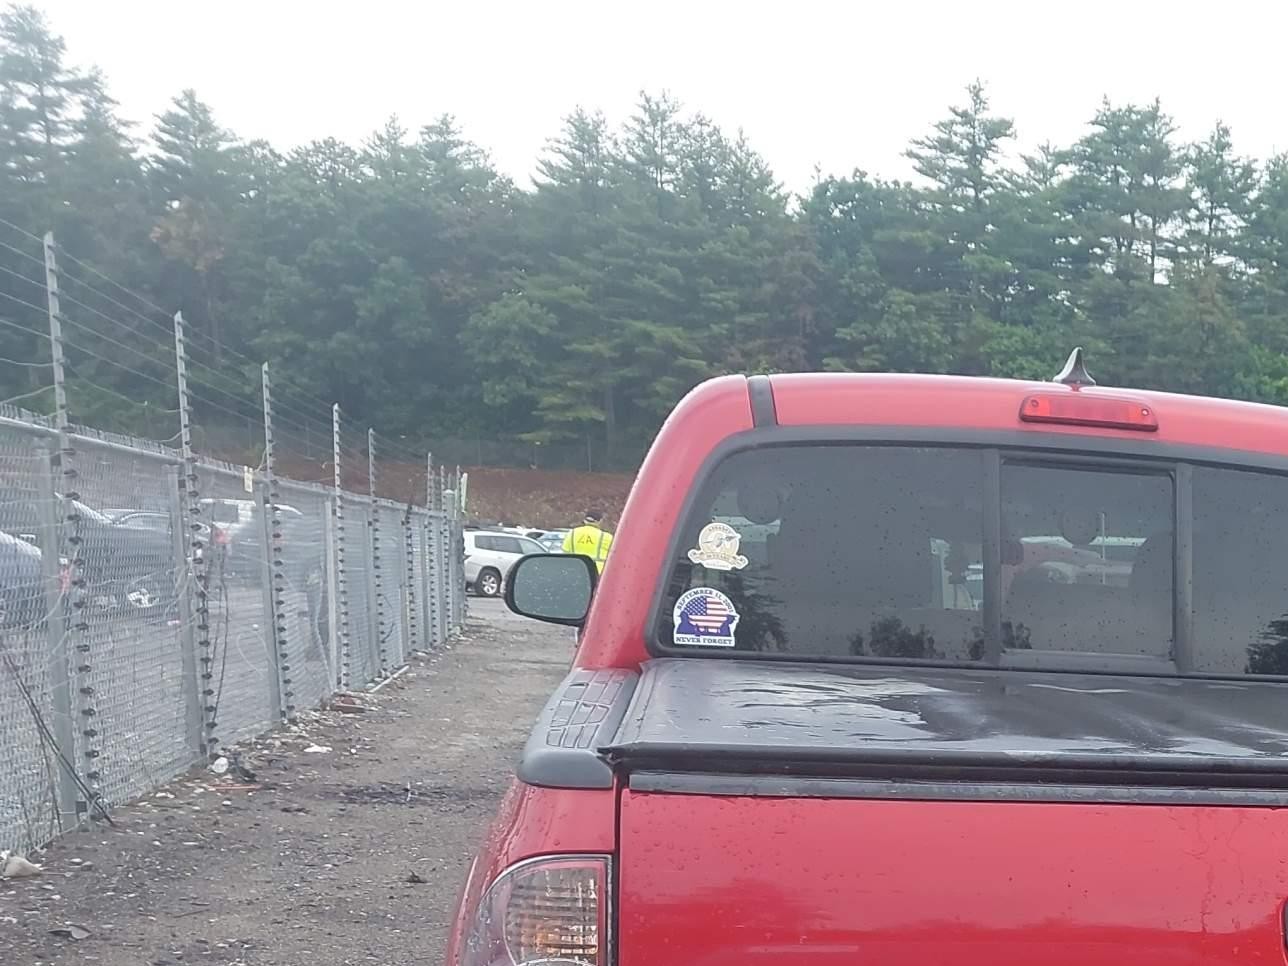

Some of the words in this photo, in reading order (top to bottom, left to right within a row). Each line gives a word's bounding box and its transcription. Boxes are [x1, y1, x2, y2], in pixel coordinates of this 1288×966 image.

[677, 589, 713, 610] SEPTEMBER
[675, 636, 702, 644] NEVER
[702, 637, 733, 645] FORGET
